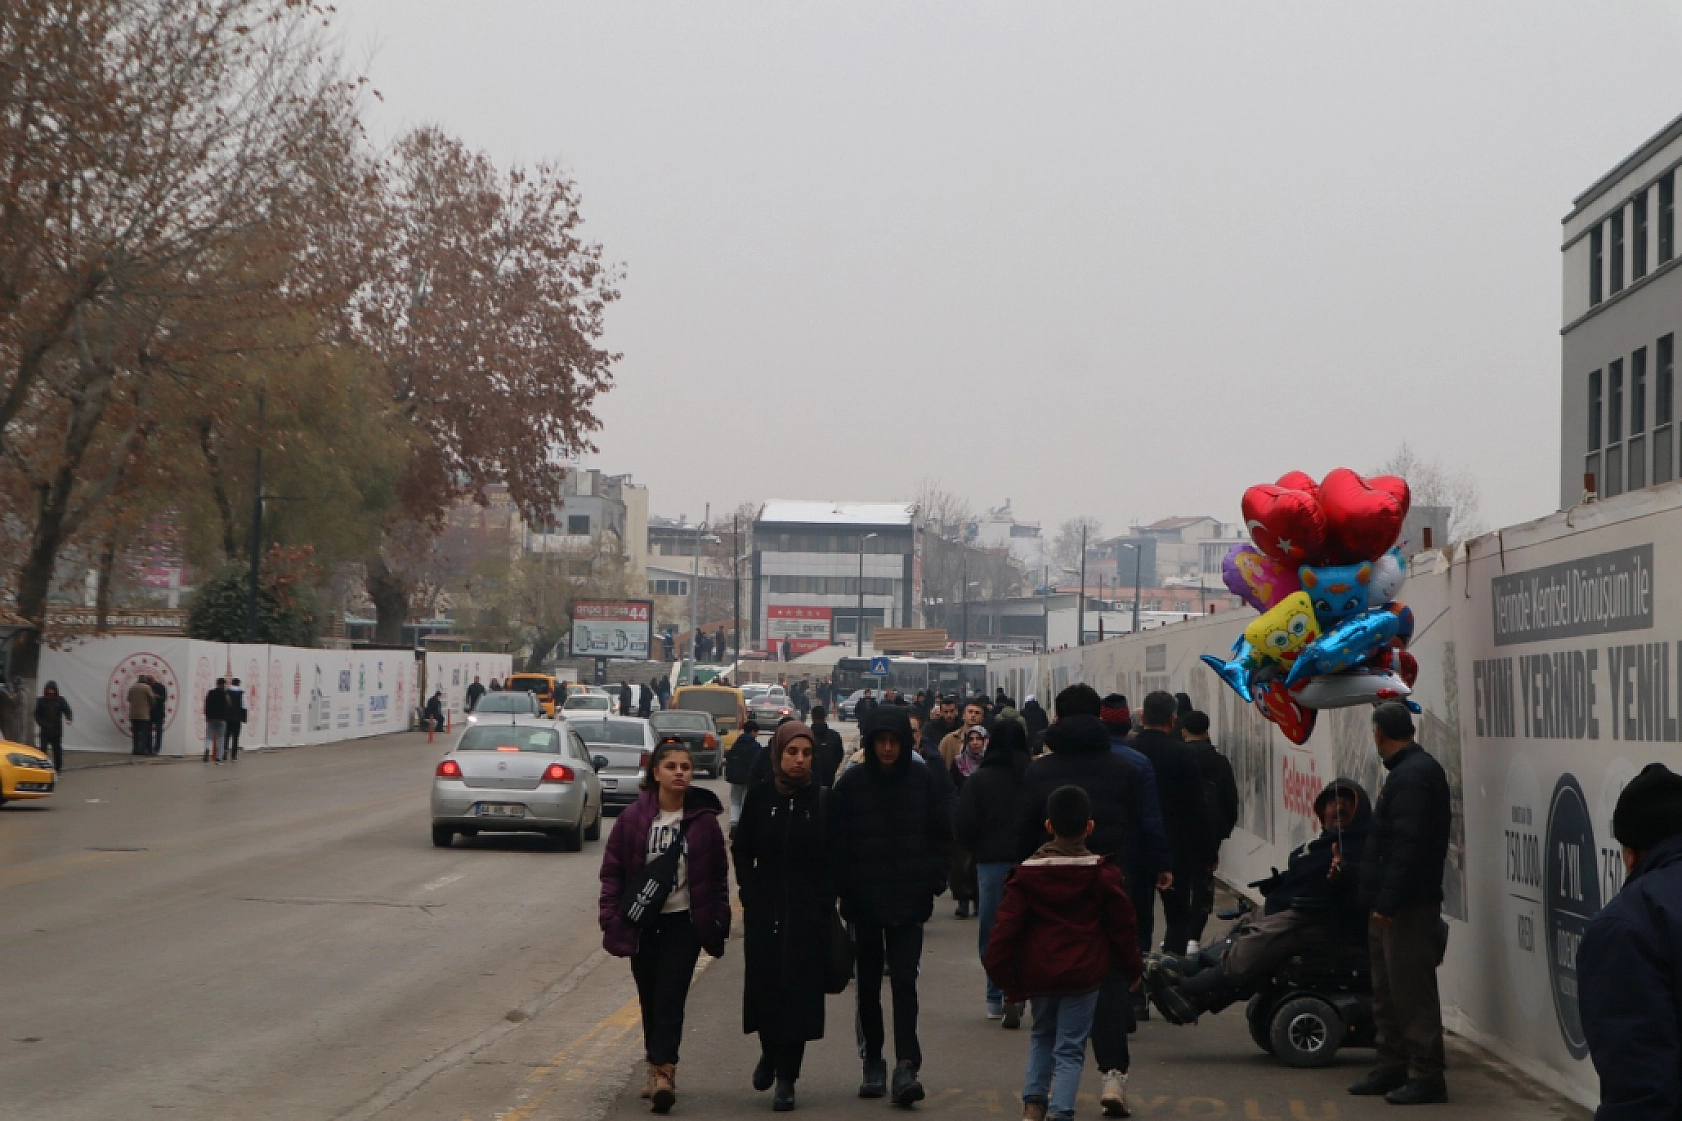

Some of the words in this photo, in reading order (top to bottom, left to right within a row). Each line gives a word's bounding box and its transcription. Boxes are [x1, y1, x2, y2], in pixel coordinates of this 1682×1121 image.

[1531, 569, 1572, 630] Kentsel
[1573, 564, 1631, 628] Dönüşüm
[1632, 555, 1649, 616] ile
